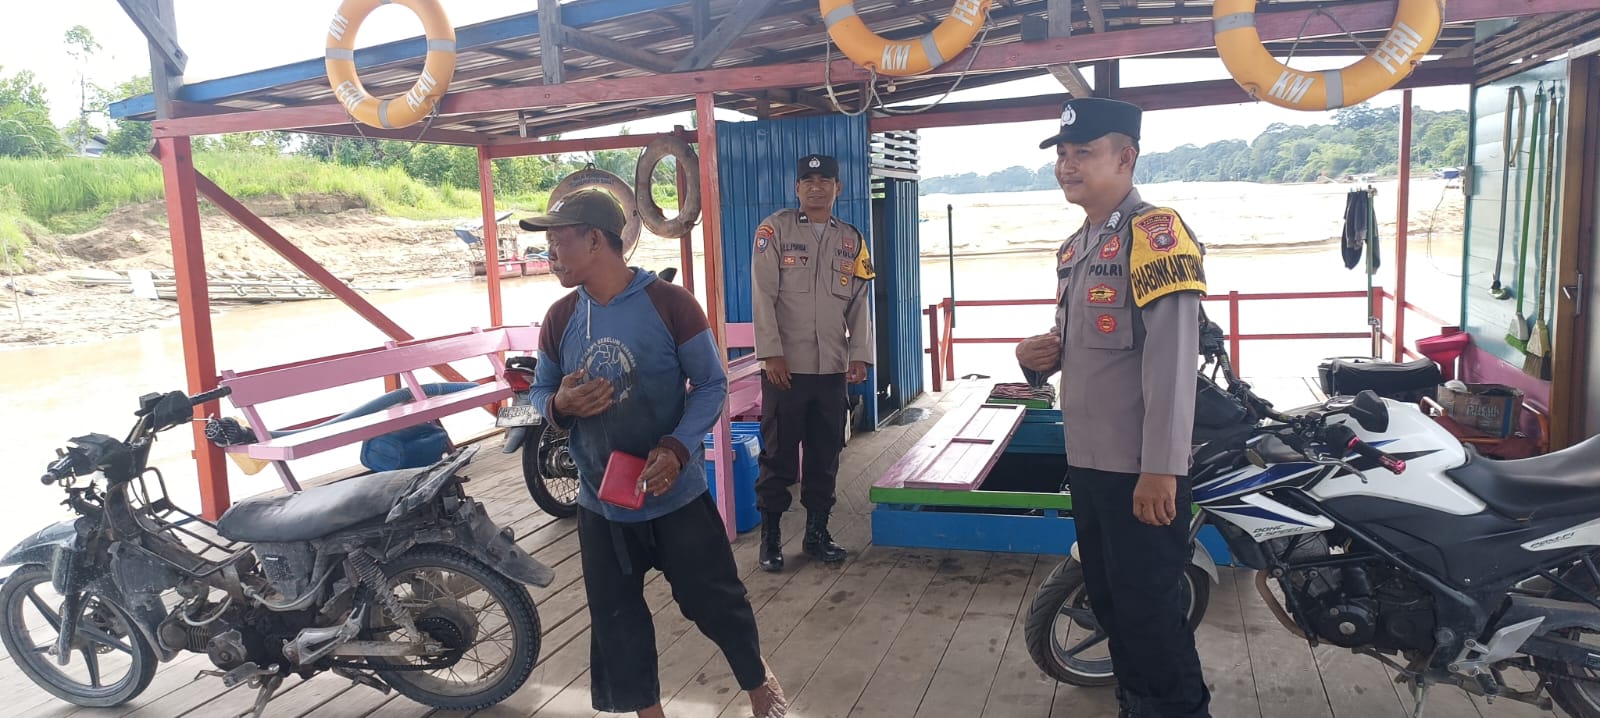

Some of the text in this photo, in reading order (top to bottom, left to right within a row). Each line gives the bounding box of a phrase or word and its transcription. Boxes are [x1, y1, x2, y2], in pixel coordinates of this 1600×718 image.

[881, 44, 912, 70] KM
[1267, 21, 1424, 104] KM FERI
[336, 80, 365, 113] FERI
[406, 68, 438, 113] ALAN
[1088, 263, 1123, 277] POLRI
[597, 336, 621, 346] SEBELUM
